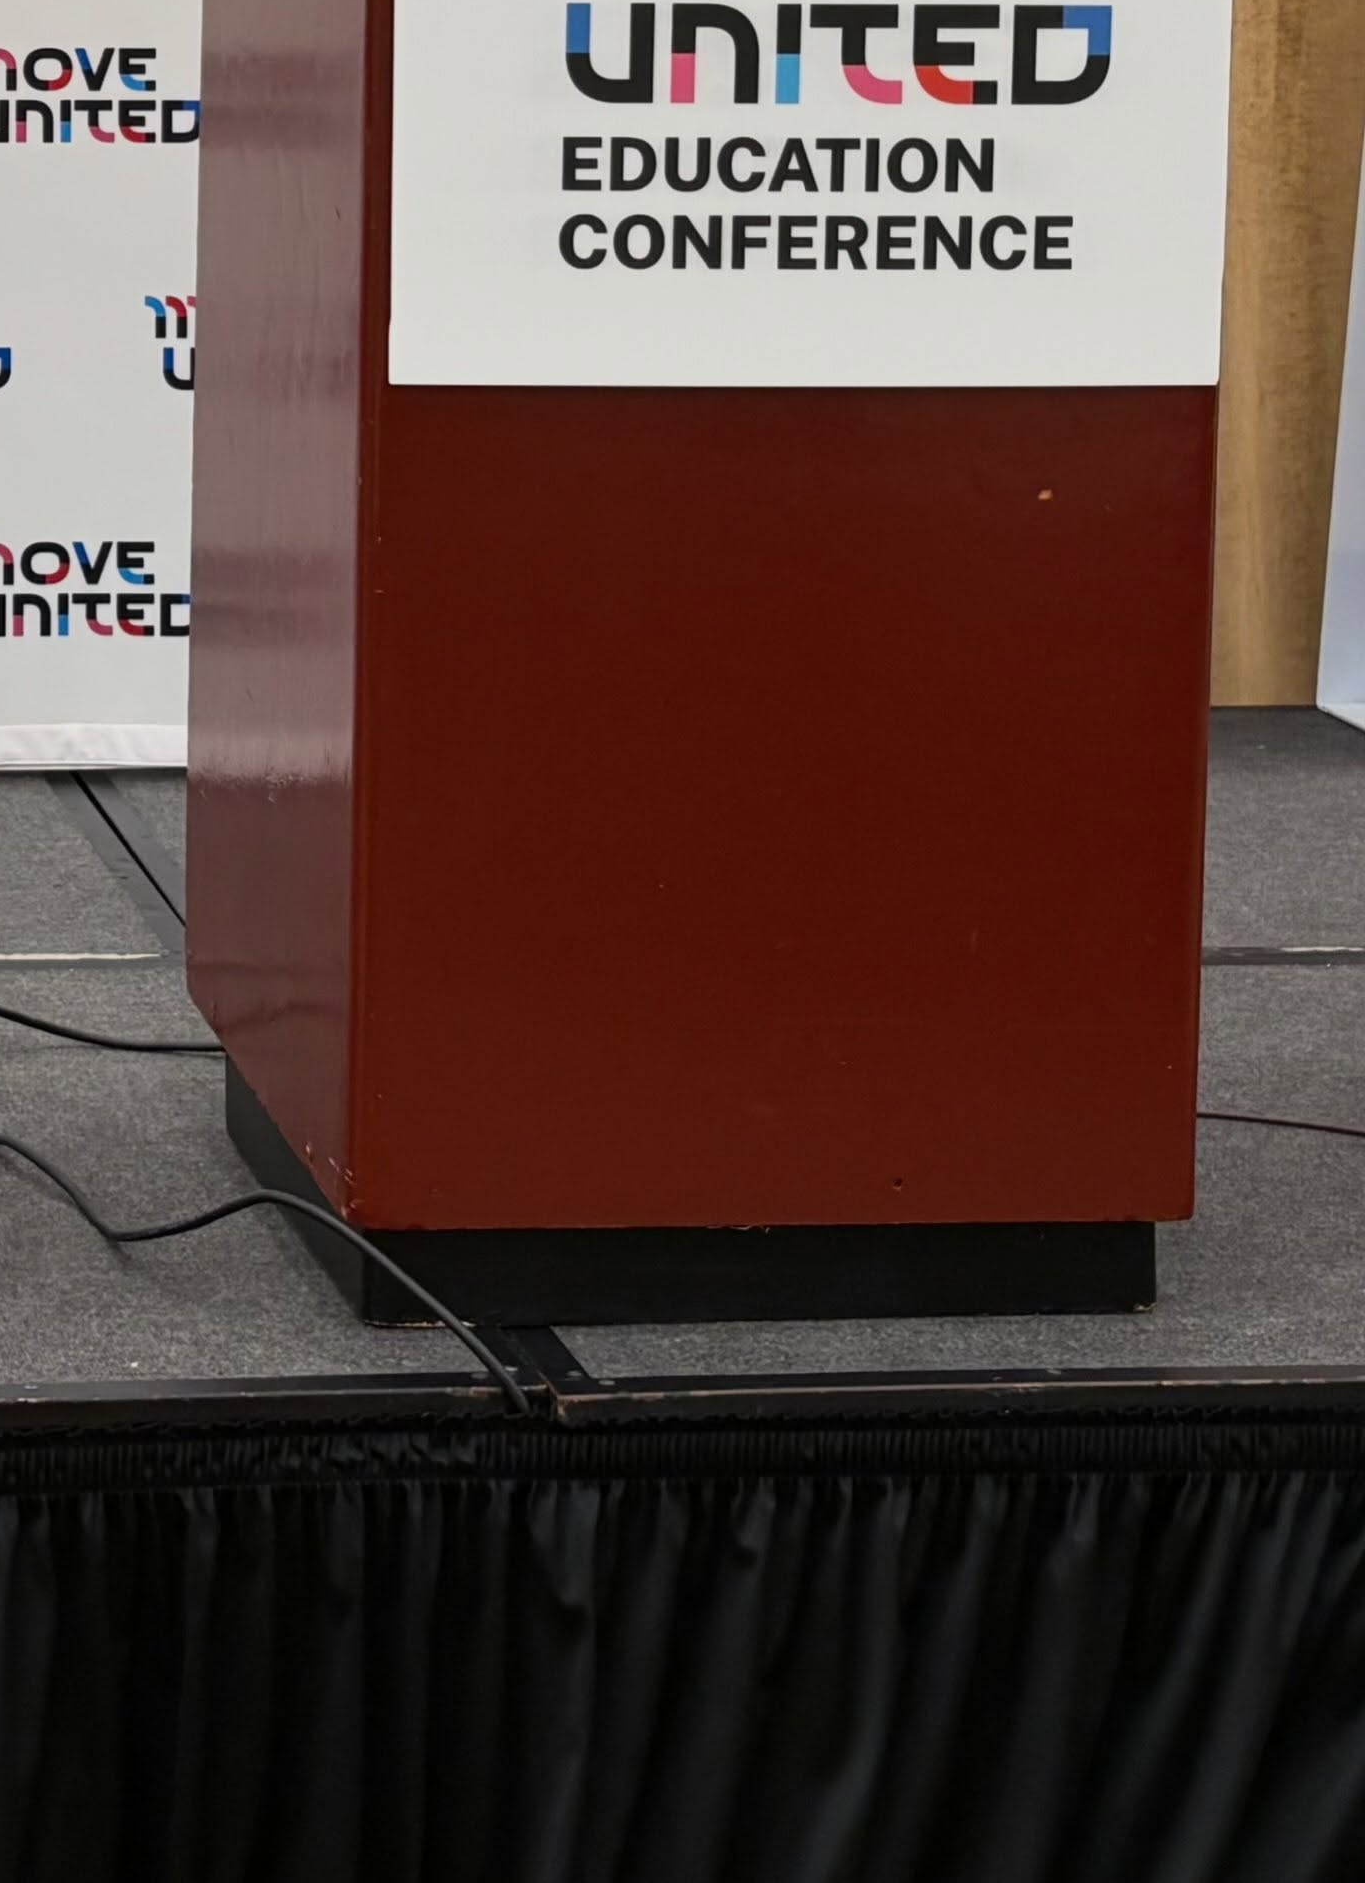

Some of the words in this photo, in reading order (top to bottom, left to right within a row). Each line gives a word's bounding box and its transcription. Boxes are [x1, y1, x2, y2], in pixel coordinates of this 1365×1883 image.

[565, 3, 1113, 105] UNITED
[561, 136, 995, 194] EDUCATION
[558, 213, 1074, 271] CONFERENCE
